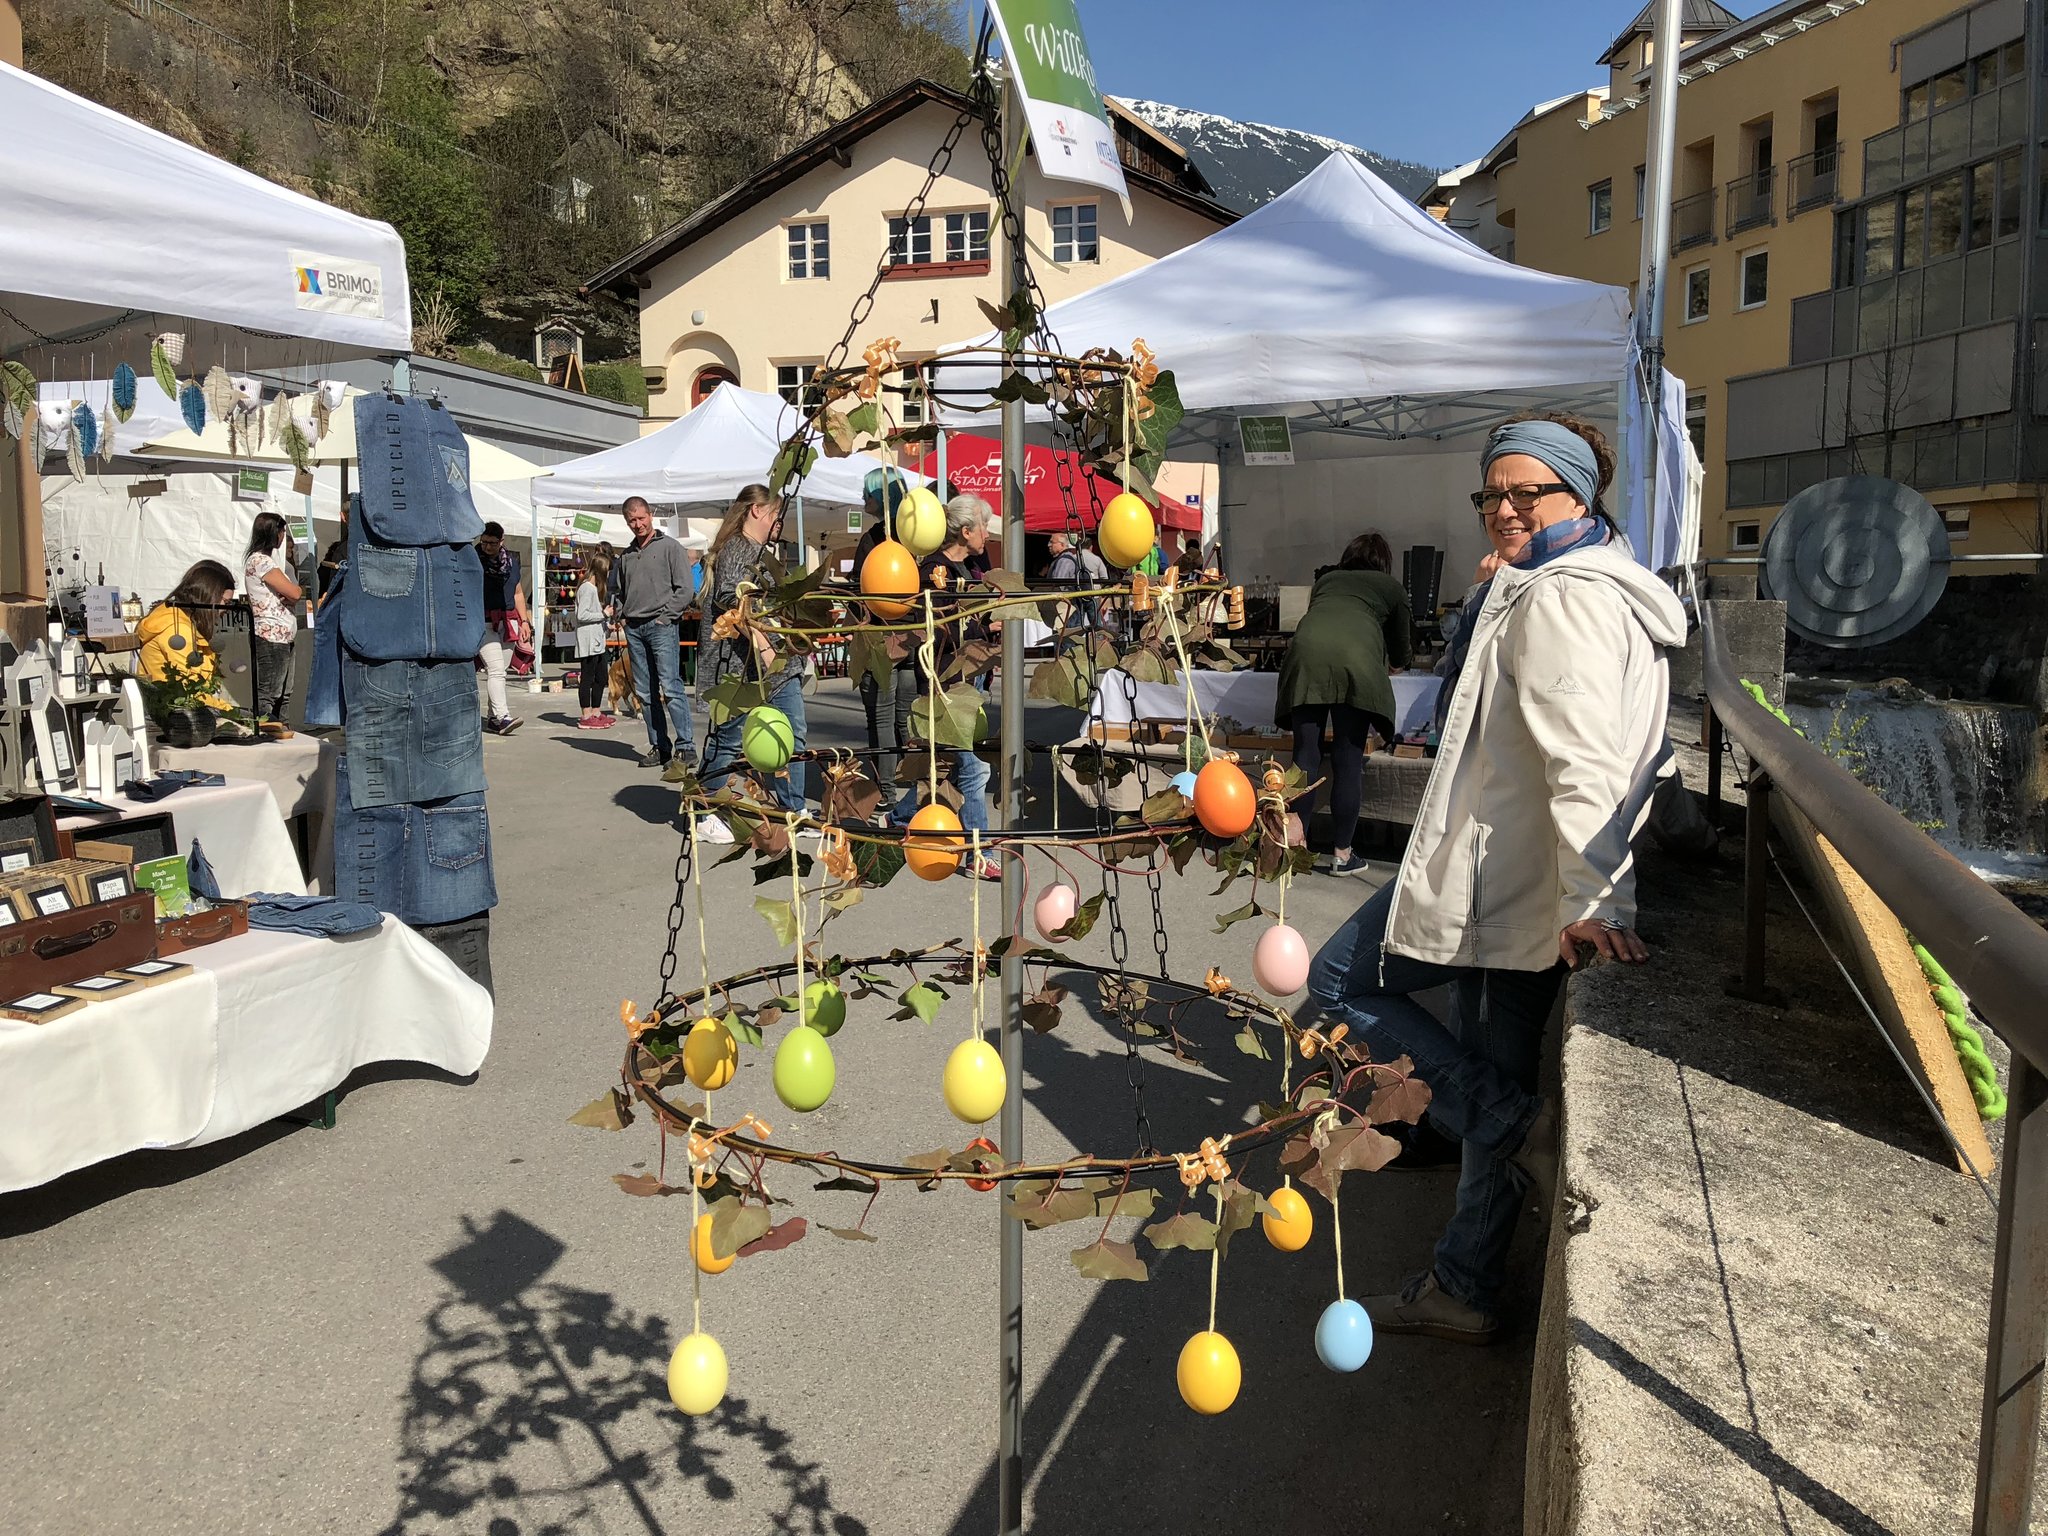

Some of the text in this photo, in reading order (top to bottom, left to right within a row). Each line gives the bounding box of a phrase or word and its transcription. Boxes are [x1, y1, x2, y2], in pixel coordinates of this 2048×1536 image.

[326, 271, 372, 294] BRIMO
[386, 413, 407, 511] UPCYCLED
[954, 475, 1039, 486] STADTIST
[365, 706, 386, 799] UPCYCLED
